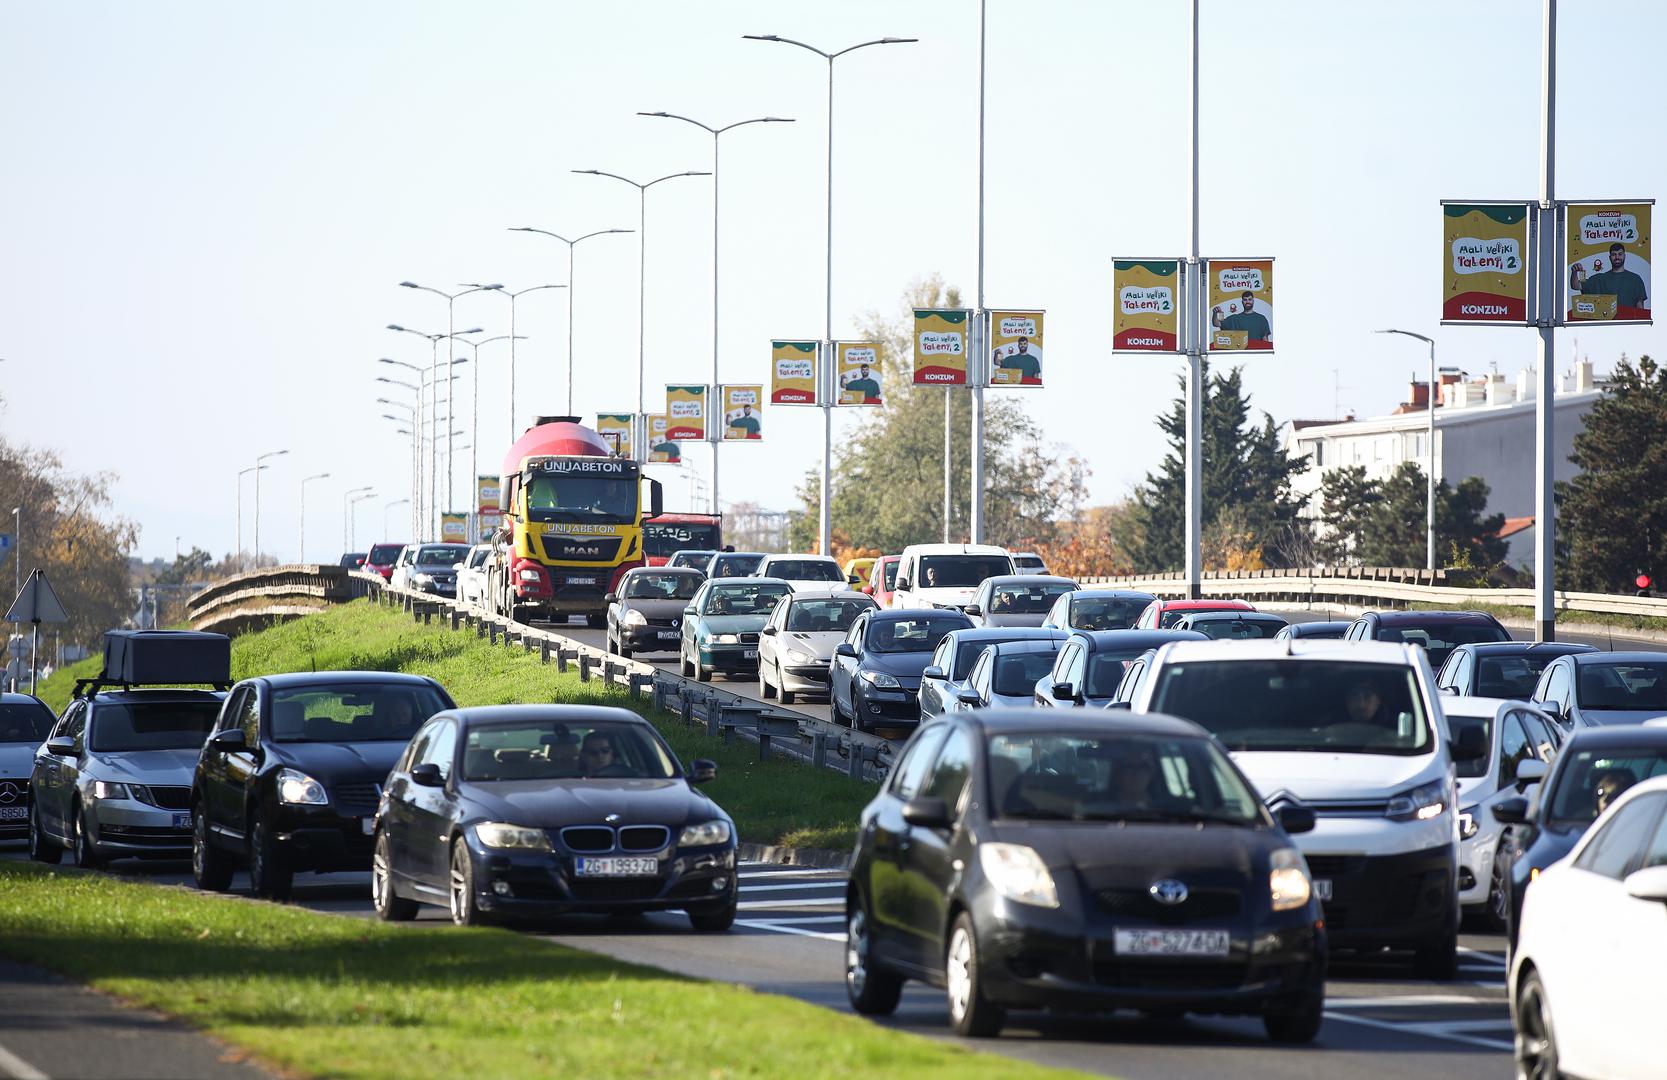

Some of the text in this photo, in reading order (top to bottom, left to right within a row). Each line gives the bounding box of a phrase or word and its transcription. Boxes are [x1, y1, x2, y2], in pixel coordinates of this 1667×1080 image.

[1626, 229, 1634, 239] 2
[1506, 256, 1516, 269] 2
[1254, 280, 1261, 288] 2
[1162, 300, 1170, 310] 2
[1461, 304, 1508, 315] KONZUM
[1127, 338, 1164, 346] KONZUM
[953, 344, 960, 352] 2
[925, 373, 955, 381] KONZUM
[544, 461, 622, 472] UNIJABETON
[548, 524, 615, 534] UNIJABETON
[564, 546, 599, 555] MAN
[586, 860, 601, 873] ZG
[1128, 930, 1151, 952] ZG
